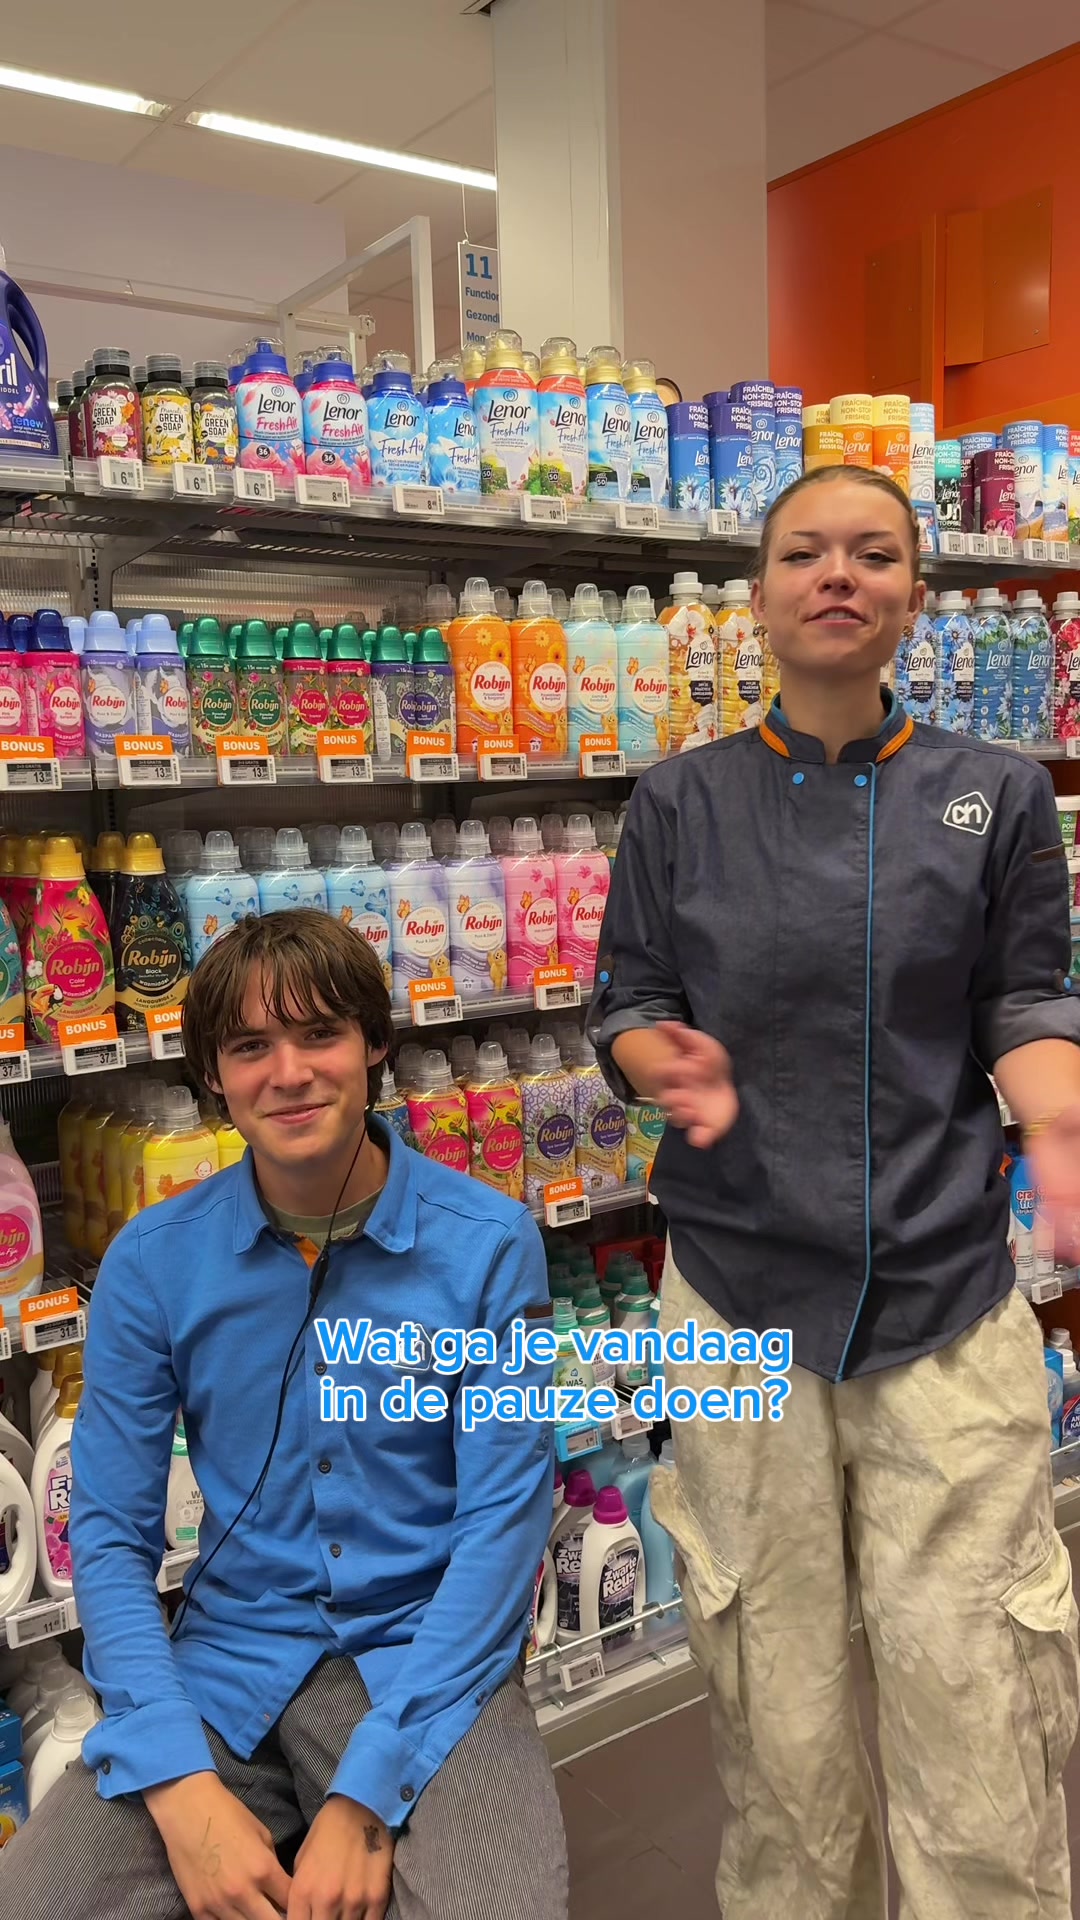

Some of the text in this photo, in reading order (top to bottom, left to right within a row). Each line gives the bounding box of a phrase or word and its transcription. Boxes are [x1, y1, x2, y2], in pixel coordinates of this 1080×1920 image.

[466, 253, 492, 279] 11
[257, 394, 296, 414] Lenor
[323, 401, 362, 421] Lenor
[94, 408, 116, 416] GREEN
[160, 413, 183, 423] GREEN
[487, 400, 531, 423] Lenor
[12, 417, 43, 428] renew
[96, 417, 114, 425] SOAP
[205, 419, 228, 427] GREEN
[384, 409, 420, 429] Lenor
[163, 423, 181, 431] SOAP
[208, 427, 226, 436] SOAP
[634, 421, 667, 441] Lenor
[775, 434, 801, 450] Lenor
[844, 440, 871, 456] Lenor
[259, 448, 268, 456] 36
[324, 454, 333, 462] 36
[474, 675, 510, 692] Robijn
[532, 676, 565, 692] Robijn
[581, 677, 615, 693] Robijn
[634, 678, 667, 694] Robijn
[52, 696, 80, 710] Robijn
[92, 695, 125, 709] Robijn
[204, 698, 232, 711] Robijn
[251, 699, 278, 711] Robijn
[301, 699, 326, 711] Robijn
[339, 700, 365, 712] Robijn
[1, 741, 45, 752] BONUS
[123, 741, 164, 751] BONUS
[223, 742, 260, 750] BONUS
[323, 736, 357, 744] BONUS
[413, 736, 445, 746] BONUS
[484, 740, 514, 748] BONUS
[406, 920, 445, 936] Robijn
[465, 915, 502, 931] Robijn
[127, 949, 177, 968] Robijn
[51, 958, 100, 977] Robijn
[539, 969, 567, 979] BONUS
[415, 982, 447, 993] BONUS
[65, 1020, 107, 1035] BONUS
[594, 1116, 625, 1133] Robijn
[540, 1126, 574, 1142] Robijn
[486, 1136, 521, 1153] Robijn
[549, 1182, 577, 1195] BONUS
[28, 1294, 70, 1312] BONUS
[603, 1568, 636, 1598] Reus
